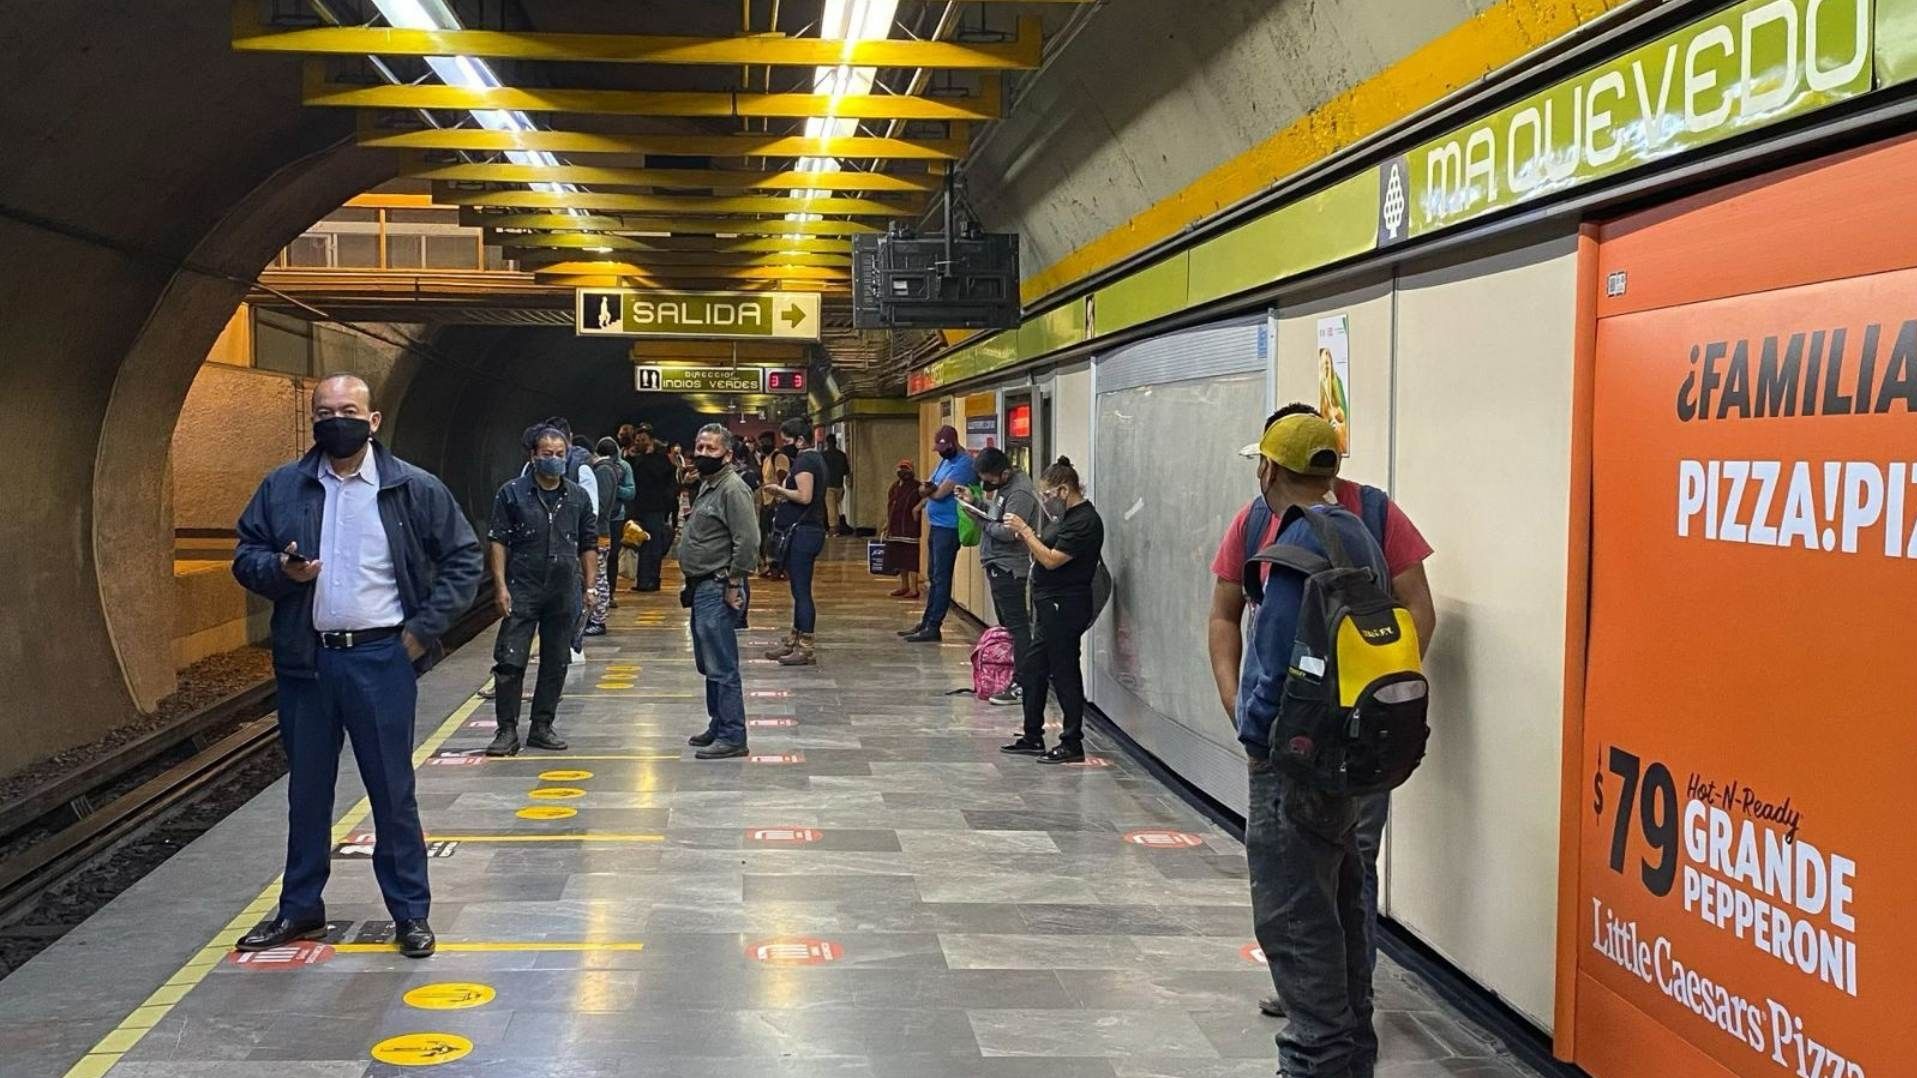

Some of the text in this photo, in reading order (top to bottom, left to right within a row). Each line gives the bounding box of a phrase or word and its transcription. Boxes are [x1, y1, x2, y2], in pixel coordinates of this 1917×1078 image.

[1426, 0, 1870, 222] MA QUEVEDO
[632, 302, 761, 325] SALIDA
[663, 379, 758, 389] INDIOS VERDES
[1684, 799, 1856, 932] GRANDE
[1687, 772, 1800, 844] Hot-N-Ready
[1592, 897, 1652, 983] Little
[1654, 937, 1764, 1053] Caesars
[1684, 865, 1857, 997] PEPPERONI
